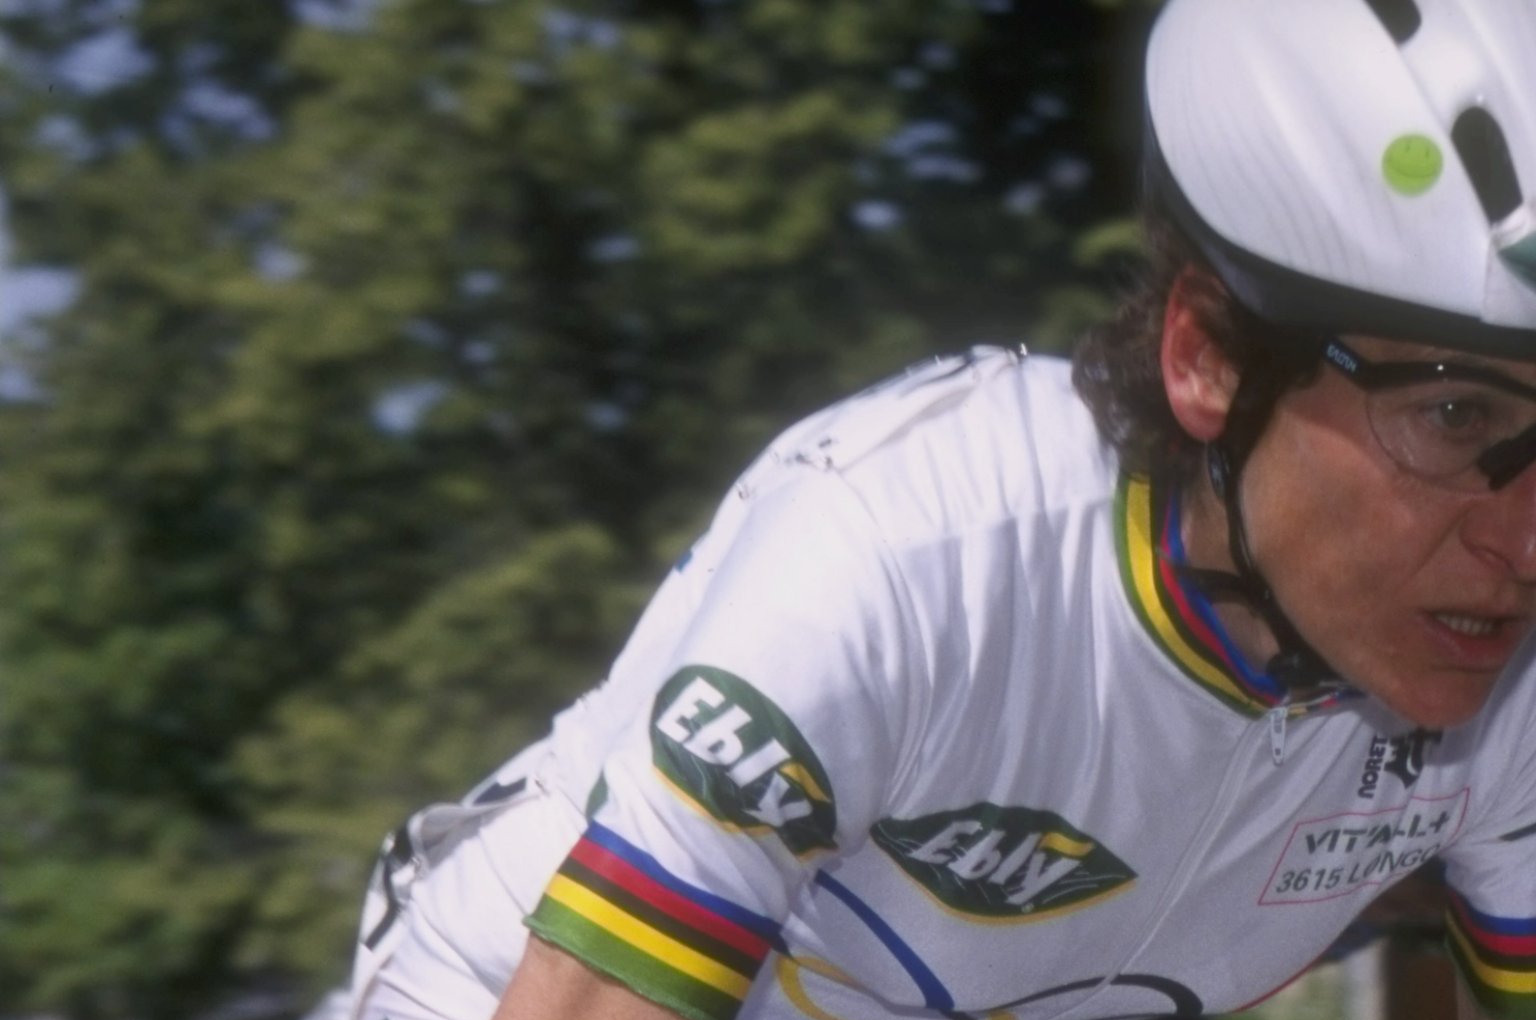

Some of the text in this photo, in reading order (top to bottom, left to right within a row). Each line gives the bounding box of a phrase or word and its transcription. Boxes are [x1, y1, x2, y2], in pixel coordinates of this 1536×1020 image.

[656, 676, 813, 827] Ebly
[910, 820, 1082, 905] Ebly
[1276, 866, 1345, 893] 3615
